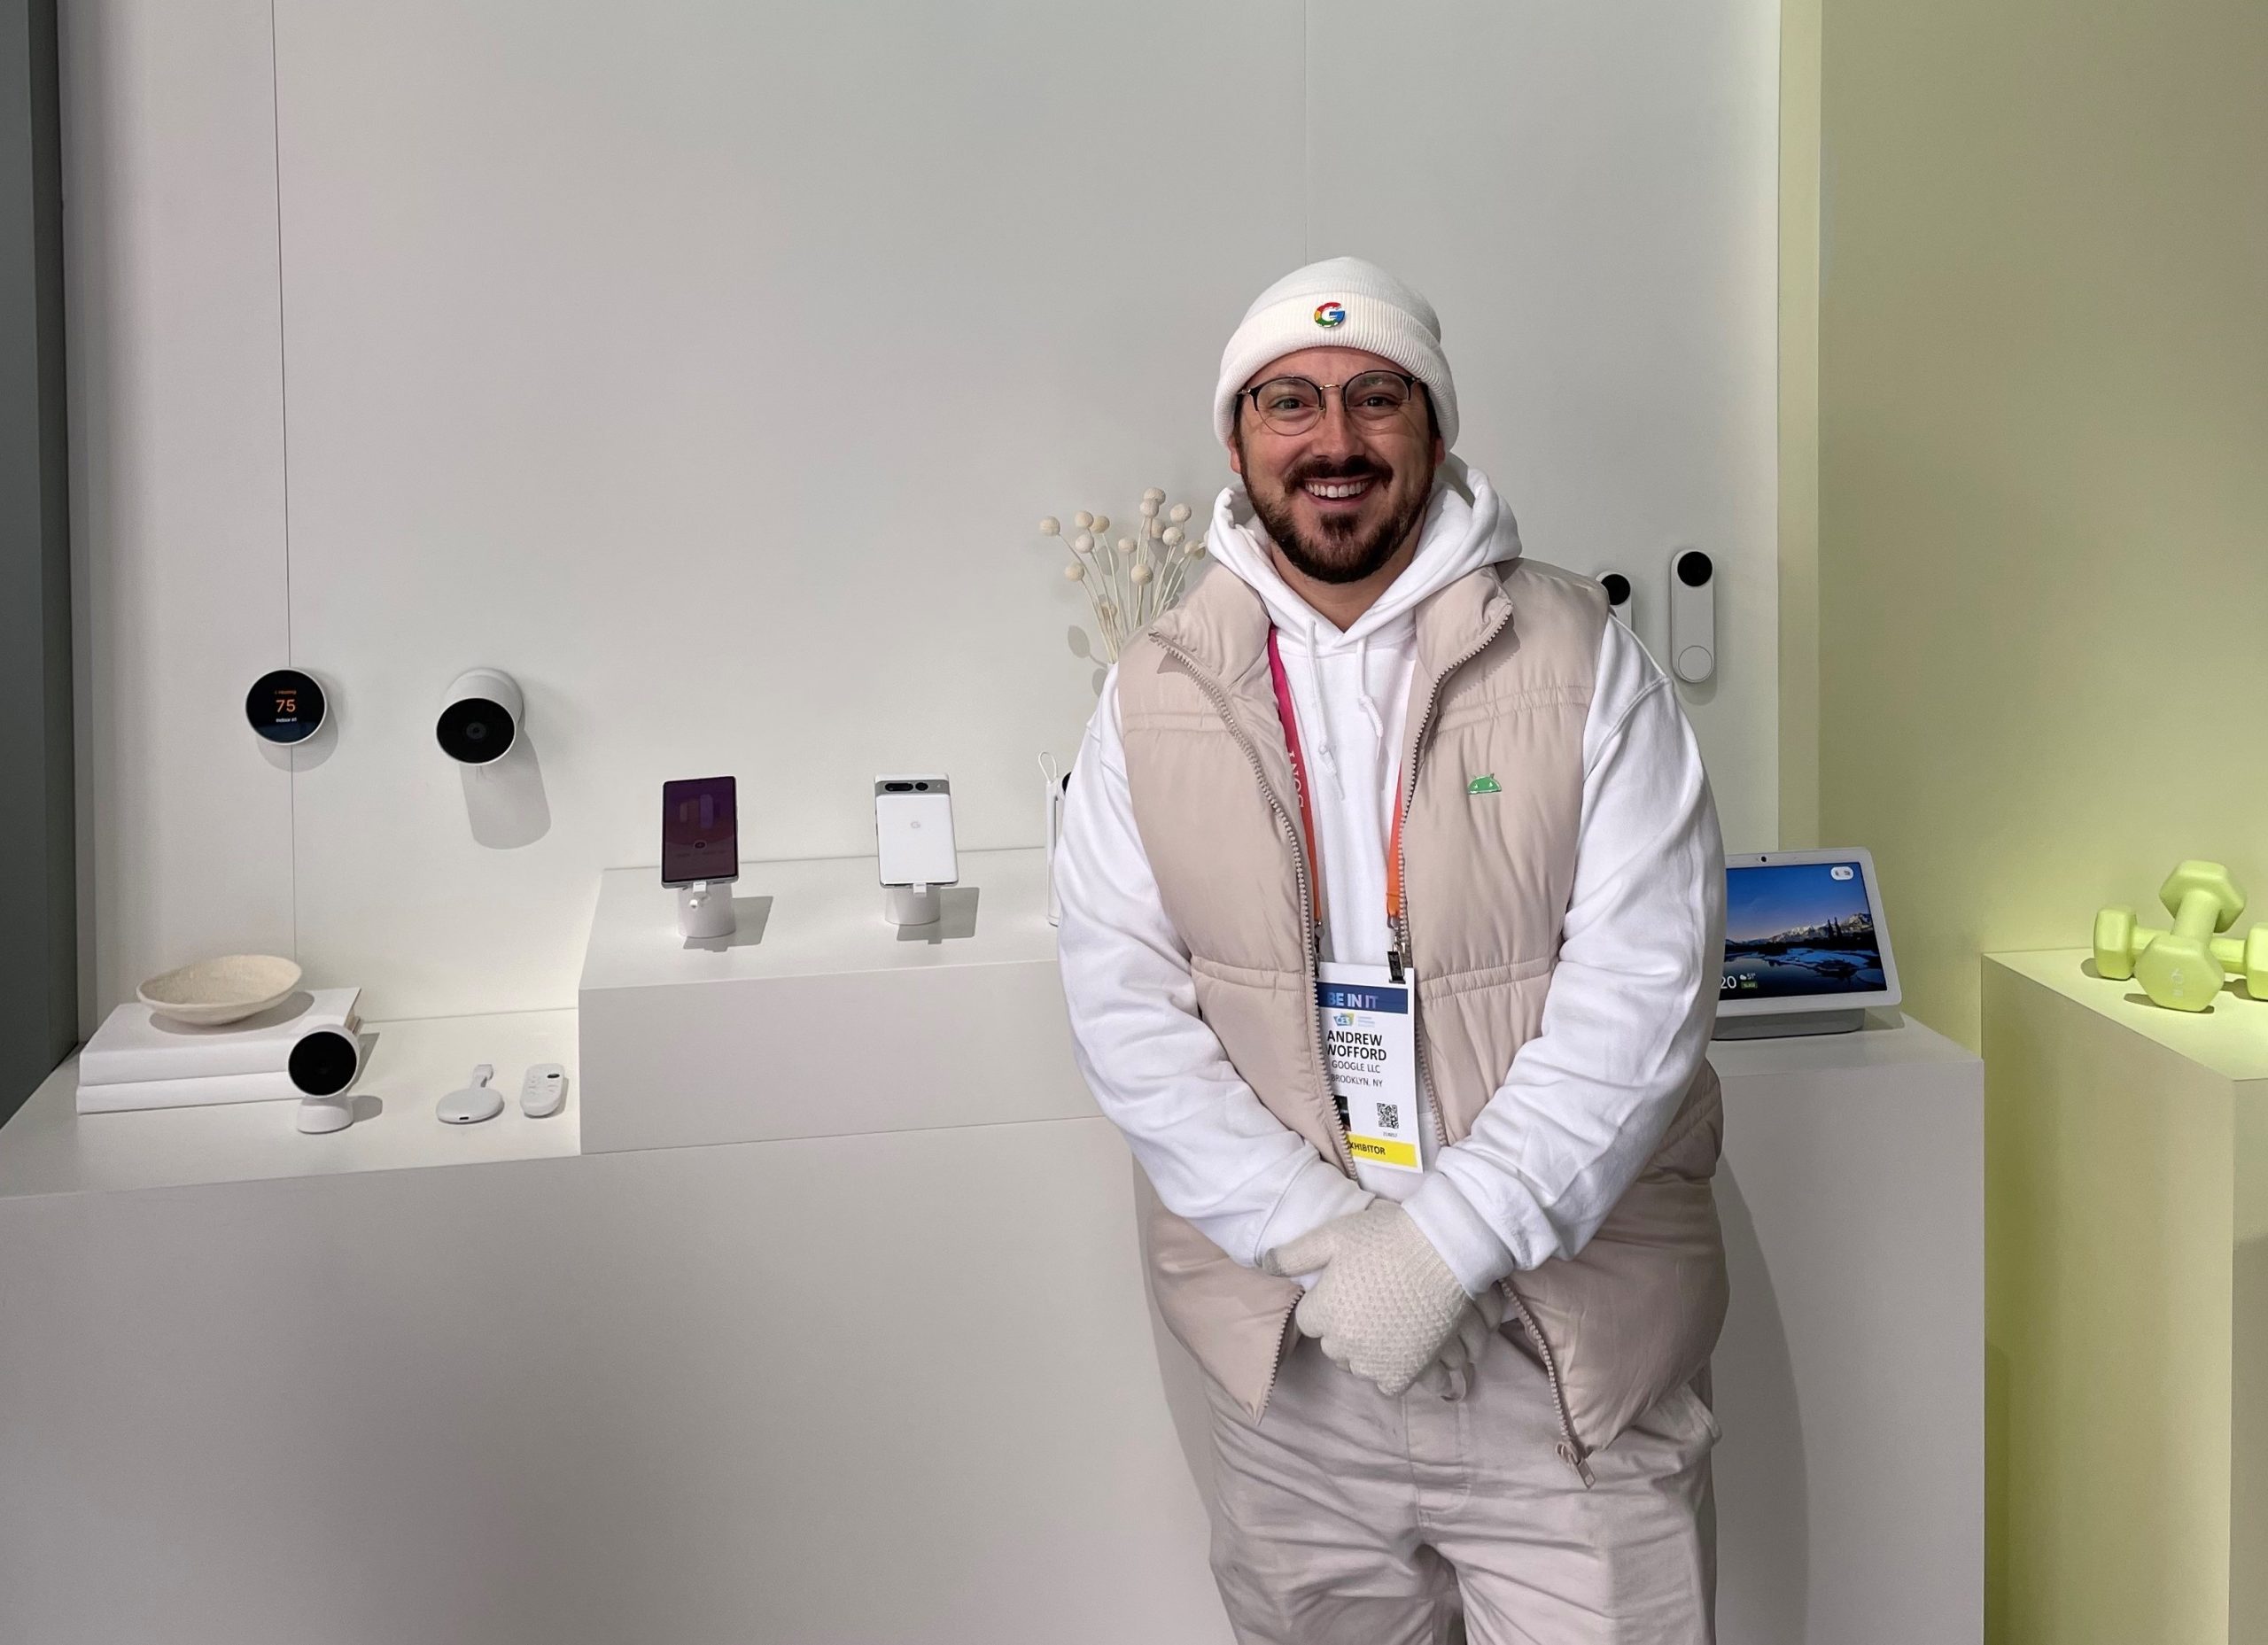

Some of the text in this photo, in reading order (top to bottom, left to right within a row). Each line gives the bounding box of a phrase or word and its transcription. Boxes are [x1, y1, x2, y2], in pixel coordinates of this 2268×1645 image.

[1313, 302, 1346, 328] G
[276, 699, 296, 713] 75
[1327, 991, 1379, 1009] BE IN IT
[1327, 1029, 1382, 1046] ANDREW
[1332, 1059, 1381, 1074] GOOGLE LLC
[1372, 1078, 1383, 1087] NY
